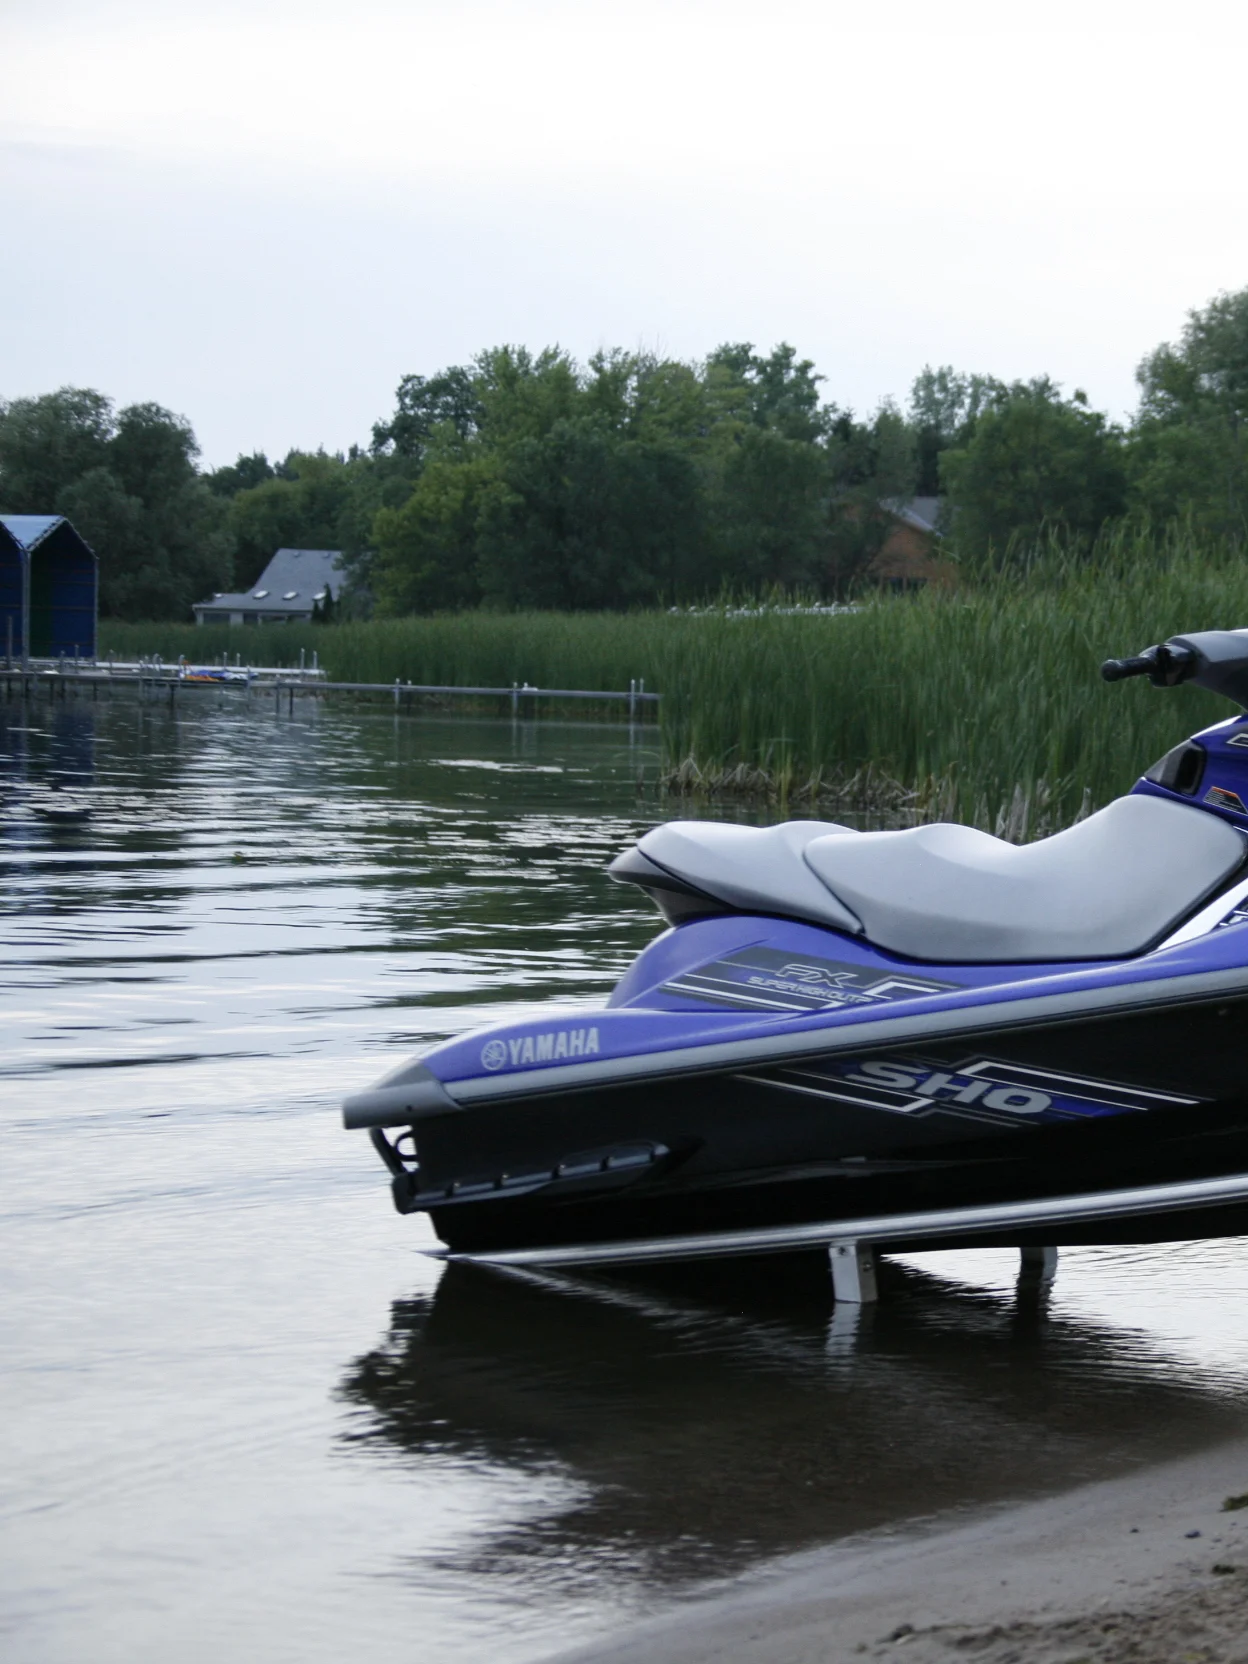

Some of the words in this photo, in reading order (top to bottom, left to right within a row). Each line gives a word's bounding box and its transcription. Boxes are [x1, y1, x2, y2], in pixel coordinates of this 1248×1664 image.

[747, 976, 797, 992] SUPER
[797, 985, 829, 997] HIGH
[775, 963, 859, 989] FX
[508, 1027, 599, 1066] YAMAHA
[845, 1061, 1052, 1114] SHO
